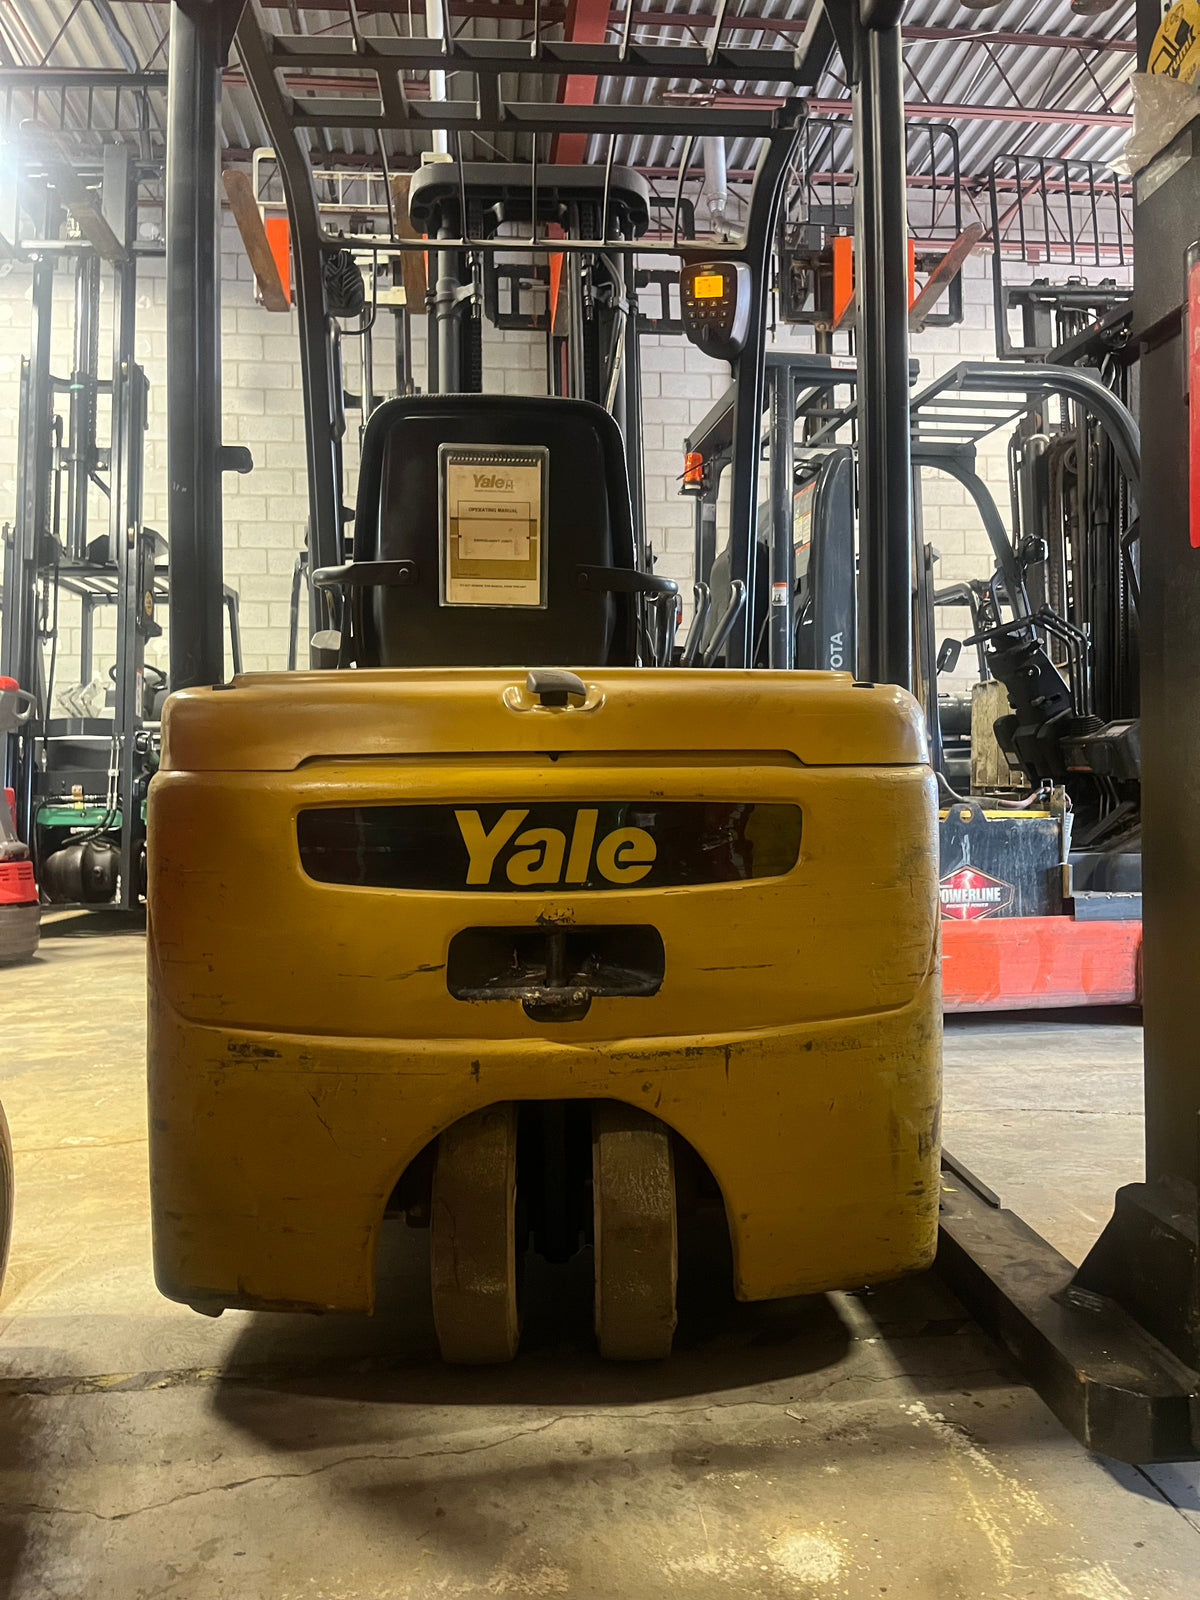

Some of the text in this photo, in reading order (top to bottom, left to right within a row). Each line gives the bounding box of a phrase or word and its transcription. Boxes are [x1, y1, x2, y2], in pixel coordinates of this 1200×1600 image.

[473, 474, 505, 489] Yale
[830, 632, 843, 671] OTA
[454, 809, 657, 886] Yale
[940, 887, 1001, 904] OWERLINE
